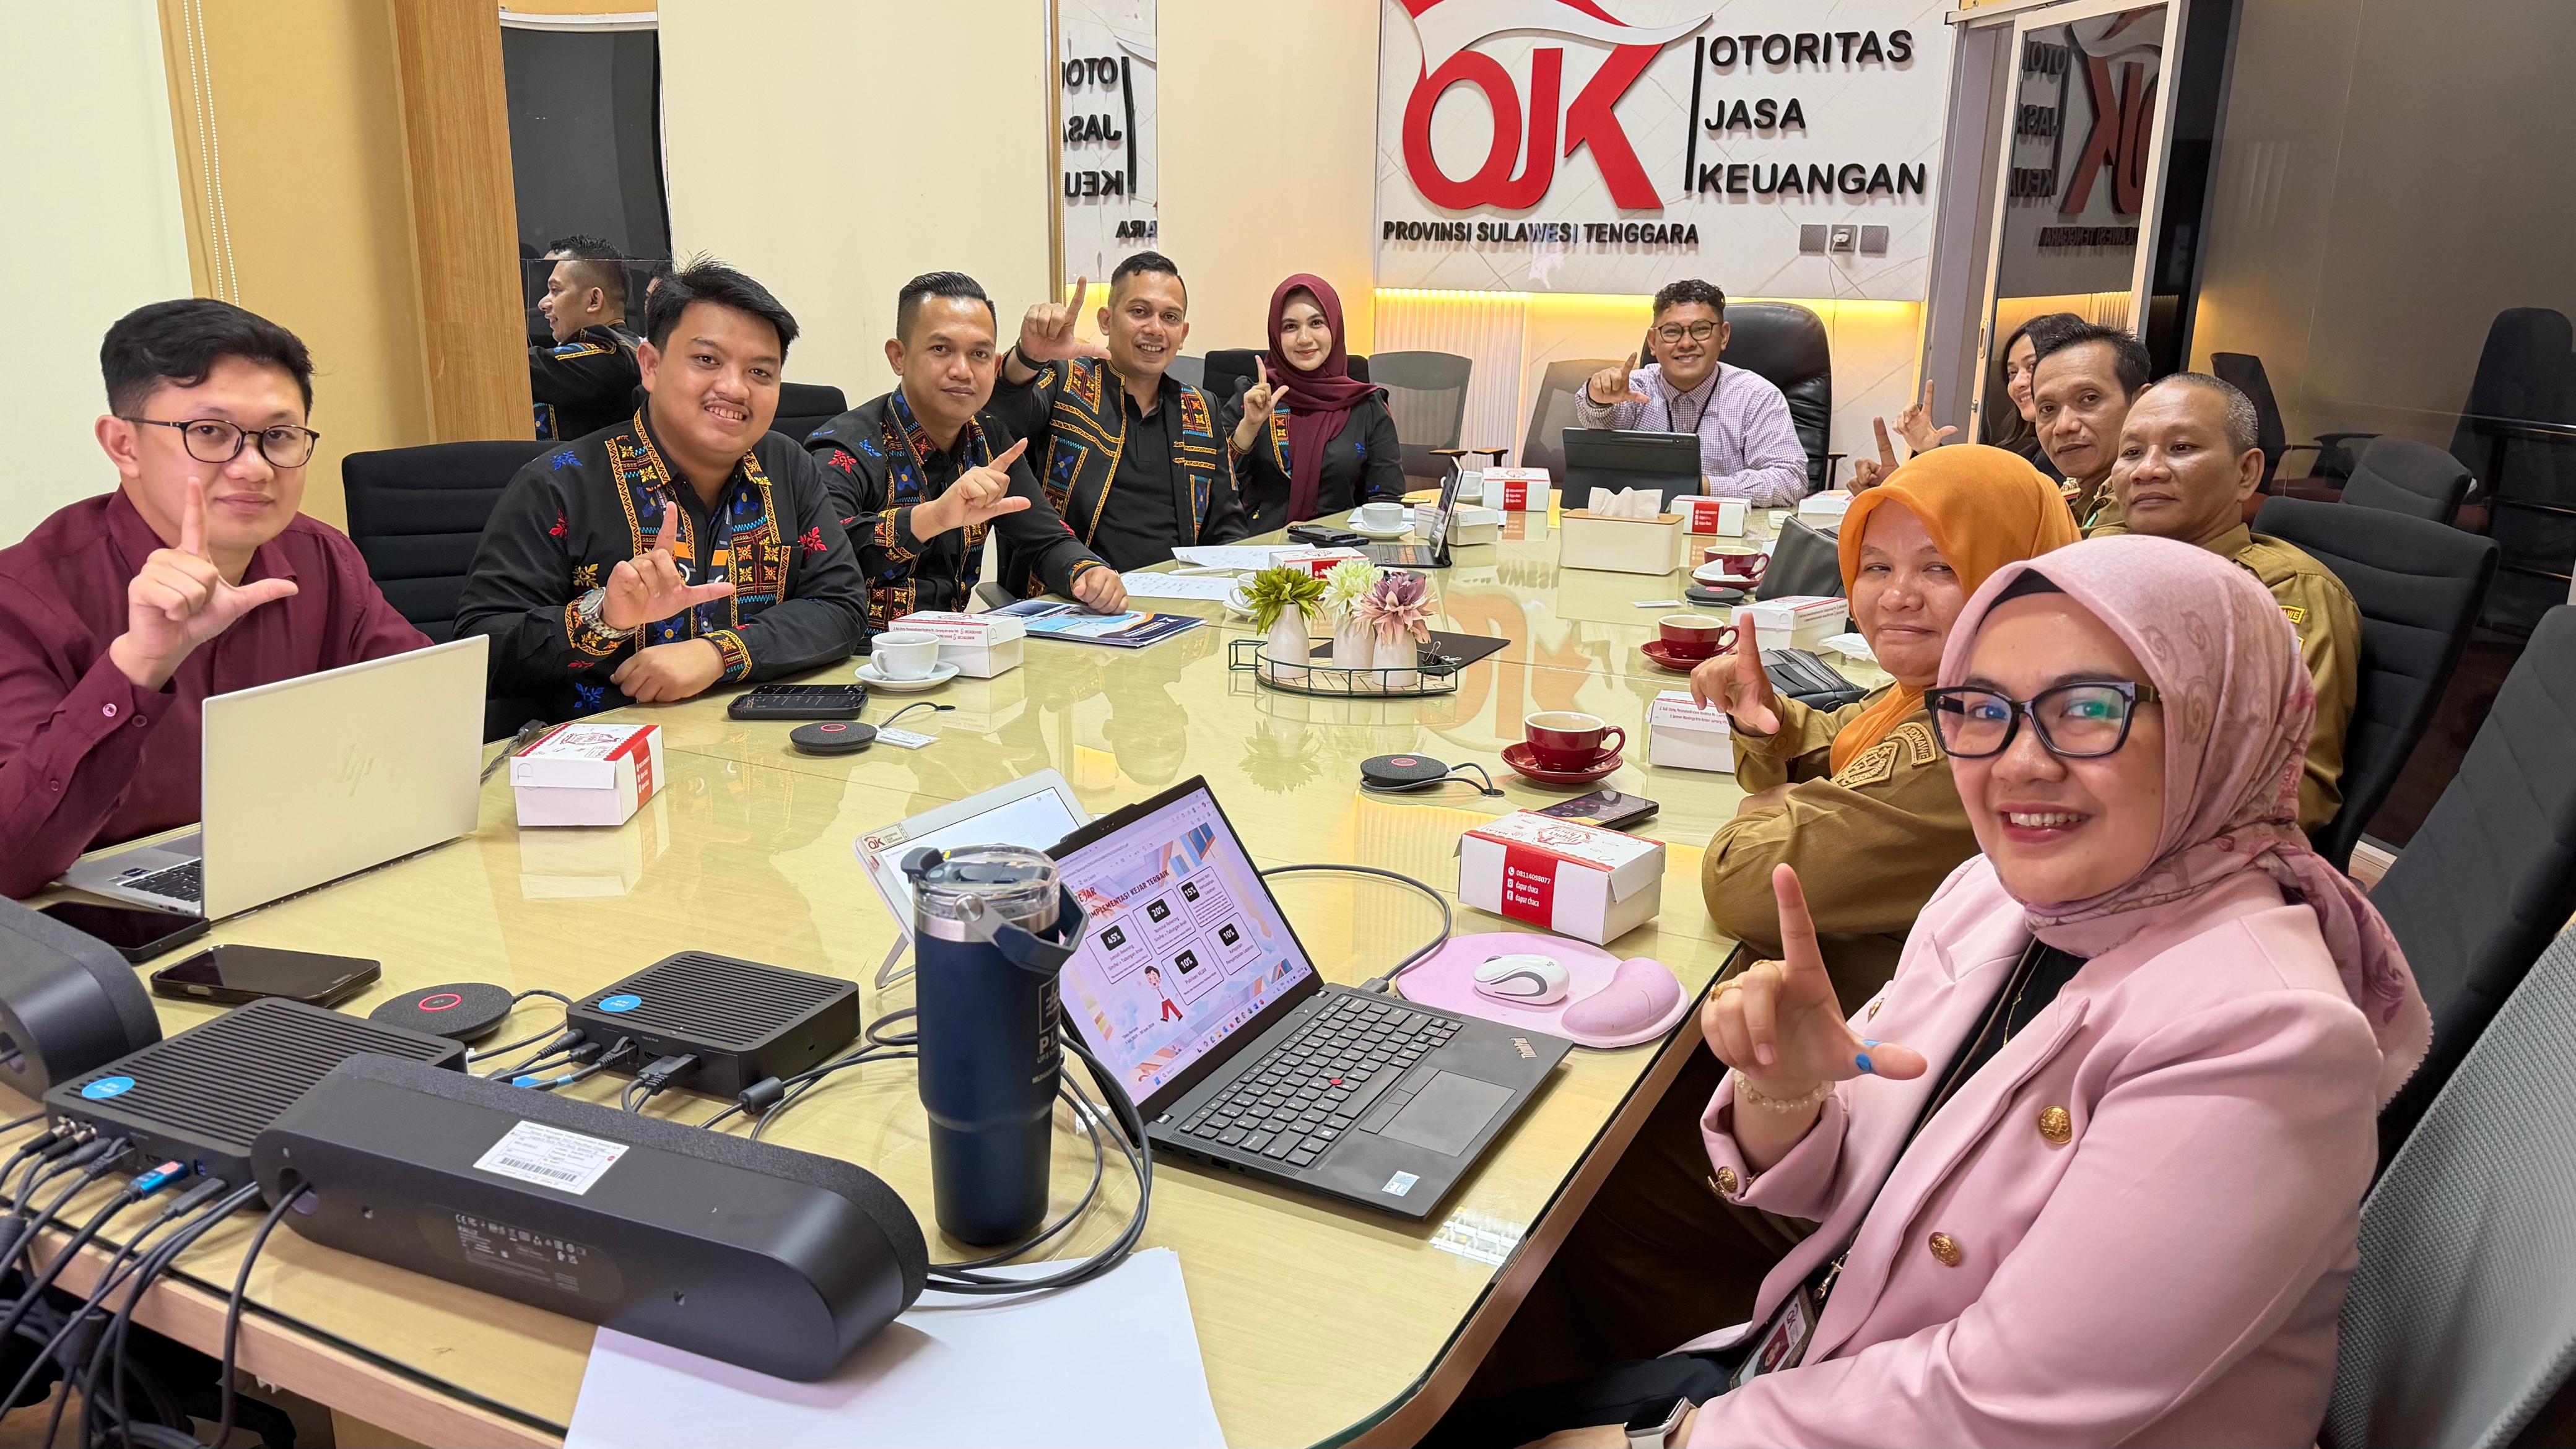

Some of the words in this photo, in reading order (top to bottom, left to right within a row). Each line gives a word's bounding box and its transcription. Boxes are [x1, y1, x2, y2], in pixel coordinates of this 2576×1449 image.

[1710, 29, 1913, 68] OTORITAS
[1402, 44, 1664, 210] OJK
[1704, 98, 1806, 131] JASA
[1697, 162, 1926, 196] KEUANGAN
[1383, 220, 1471, 243] PROVINSI
[1477, 222, 1578, 244] SULAWESI
[1583, 222, 1699, 245] TENGGARA
[1089, 890, 1131, 920] IMPLEMENTASI
[1129, 881, 1147, 896] KEJAR
[1146, 869, 1169, 886] TERBAIK
[1184, 886, 1196, 897] 15%
[1151, 904, 1165, 917] 20%
[1105, 931, 1121, 945] 45%
[1222, 928, 1235, 940] 10%
[1179, 955, 1193, 968] 10%
